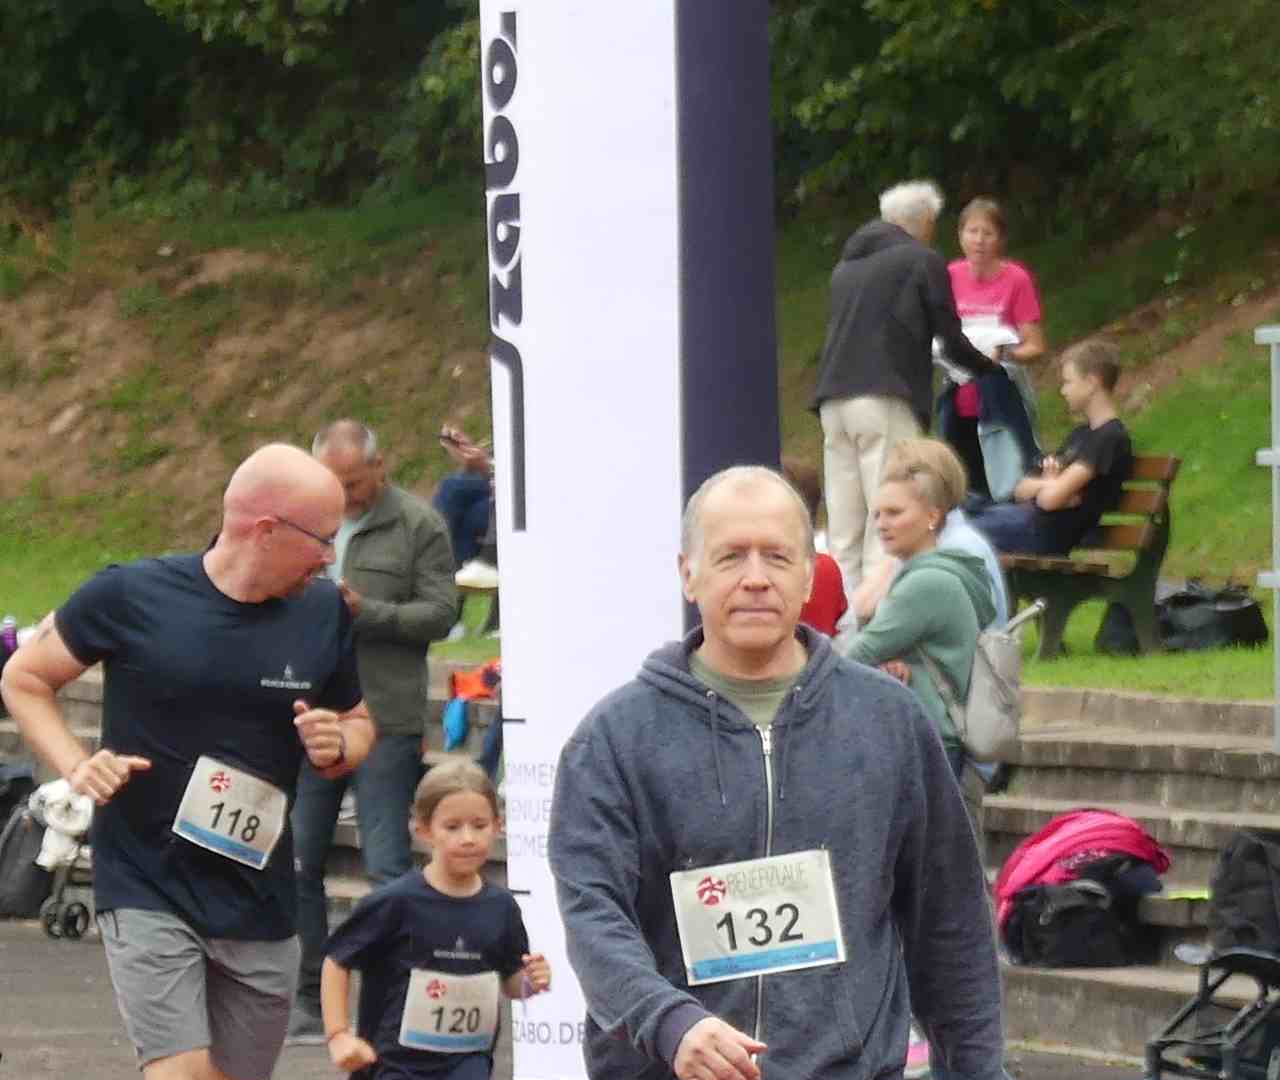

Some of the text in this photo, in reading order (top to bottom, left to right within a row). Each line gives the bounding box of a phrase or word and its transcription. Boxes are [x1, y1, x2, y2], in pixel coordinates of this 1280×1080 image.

[209, 802, 260, 843] 118
[716, 903, 804, 951] 132
[431, 1006, 481, 1033] 120
